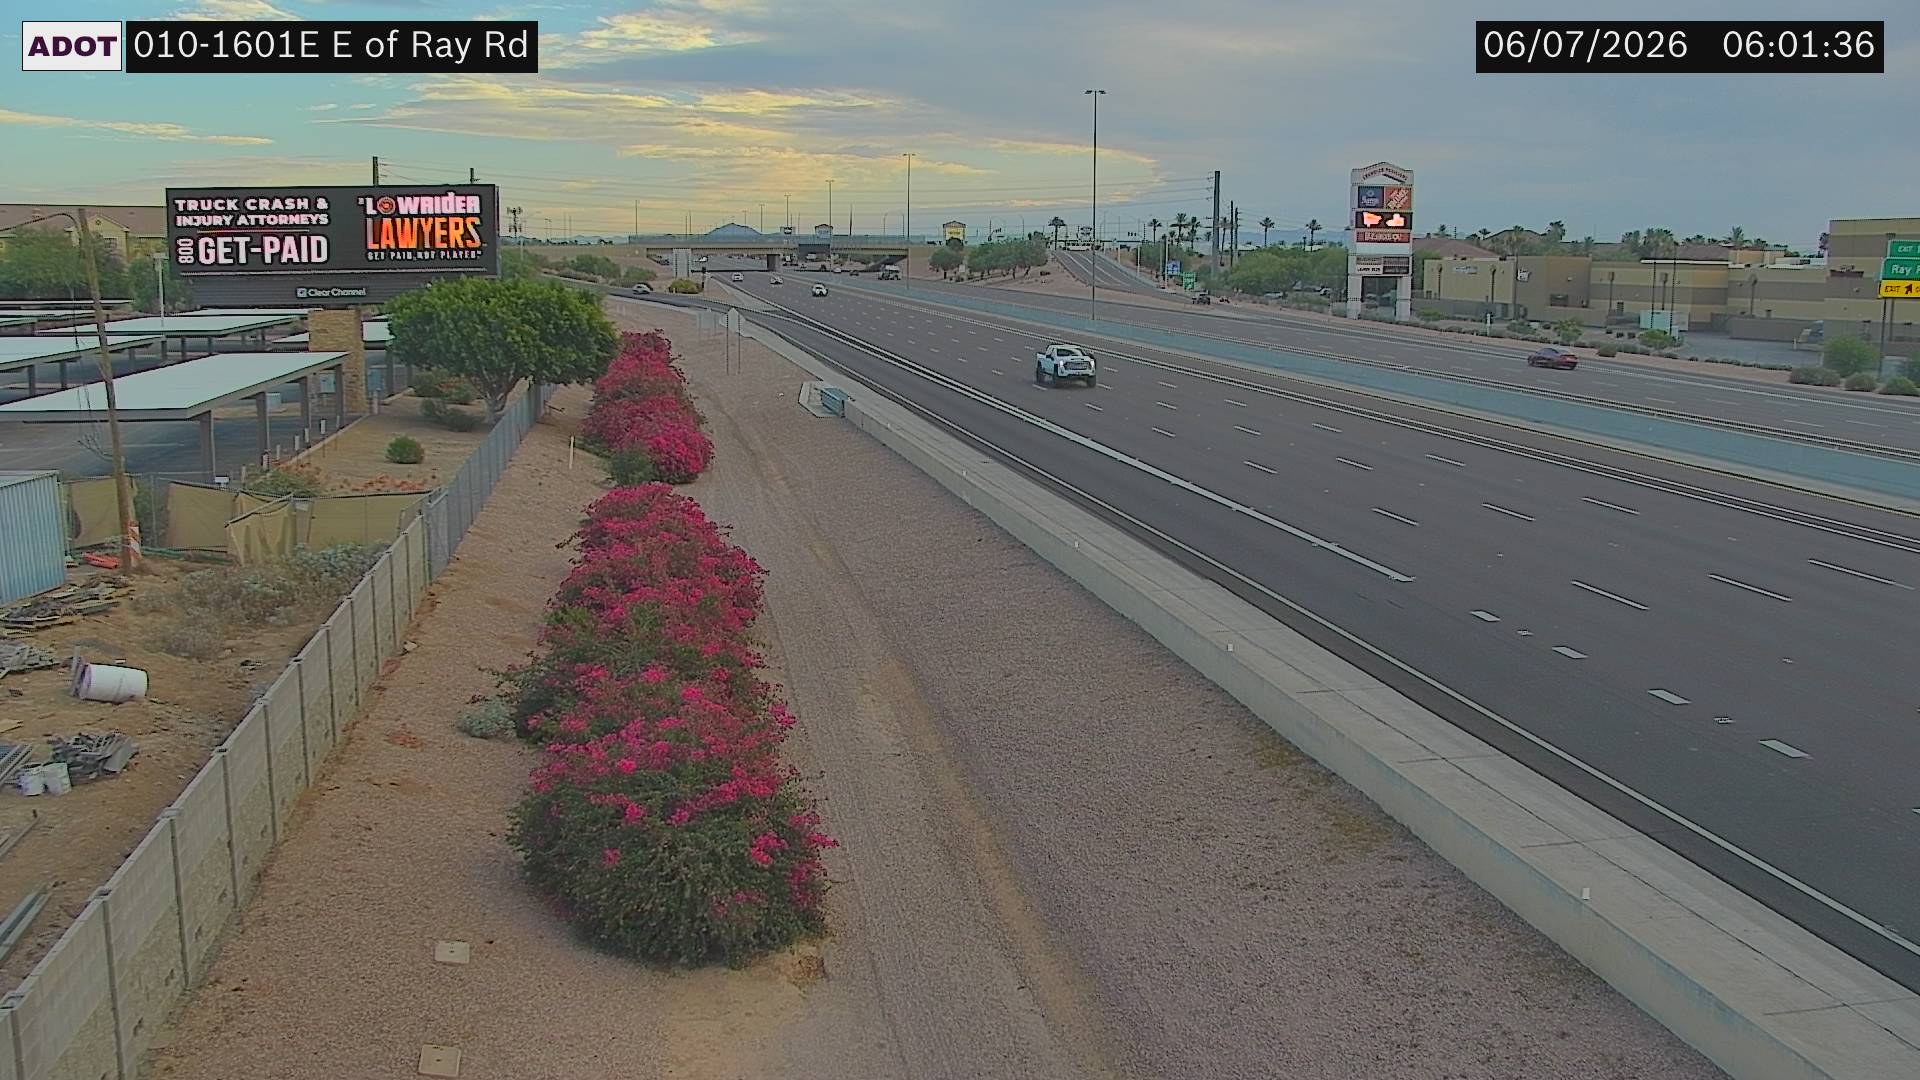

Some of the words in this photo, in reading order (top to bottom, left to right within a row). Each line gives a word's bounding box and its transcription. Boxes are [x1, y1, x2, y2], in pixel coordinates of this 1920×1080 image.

[174, 199, 240, 211] TRUCK
[245, 198, 309, 210] CRASH
[316, 198, 329, 210] &
[175, 215, 235, 226] INJURY
[237, 213, 329, 226] ATTORNEYS
[366, 216, 482, 249] LAWYERS
[177, 238, 194, 263] 800
[198, 235, 329, 264] GET-PAID
[1891, 264, 1912, 276] Ray
[308, 288, 330, 297] Clear
[331, 287, 366, 297] Channel
